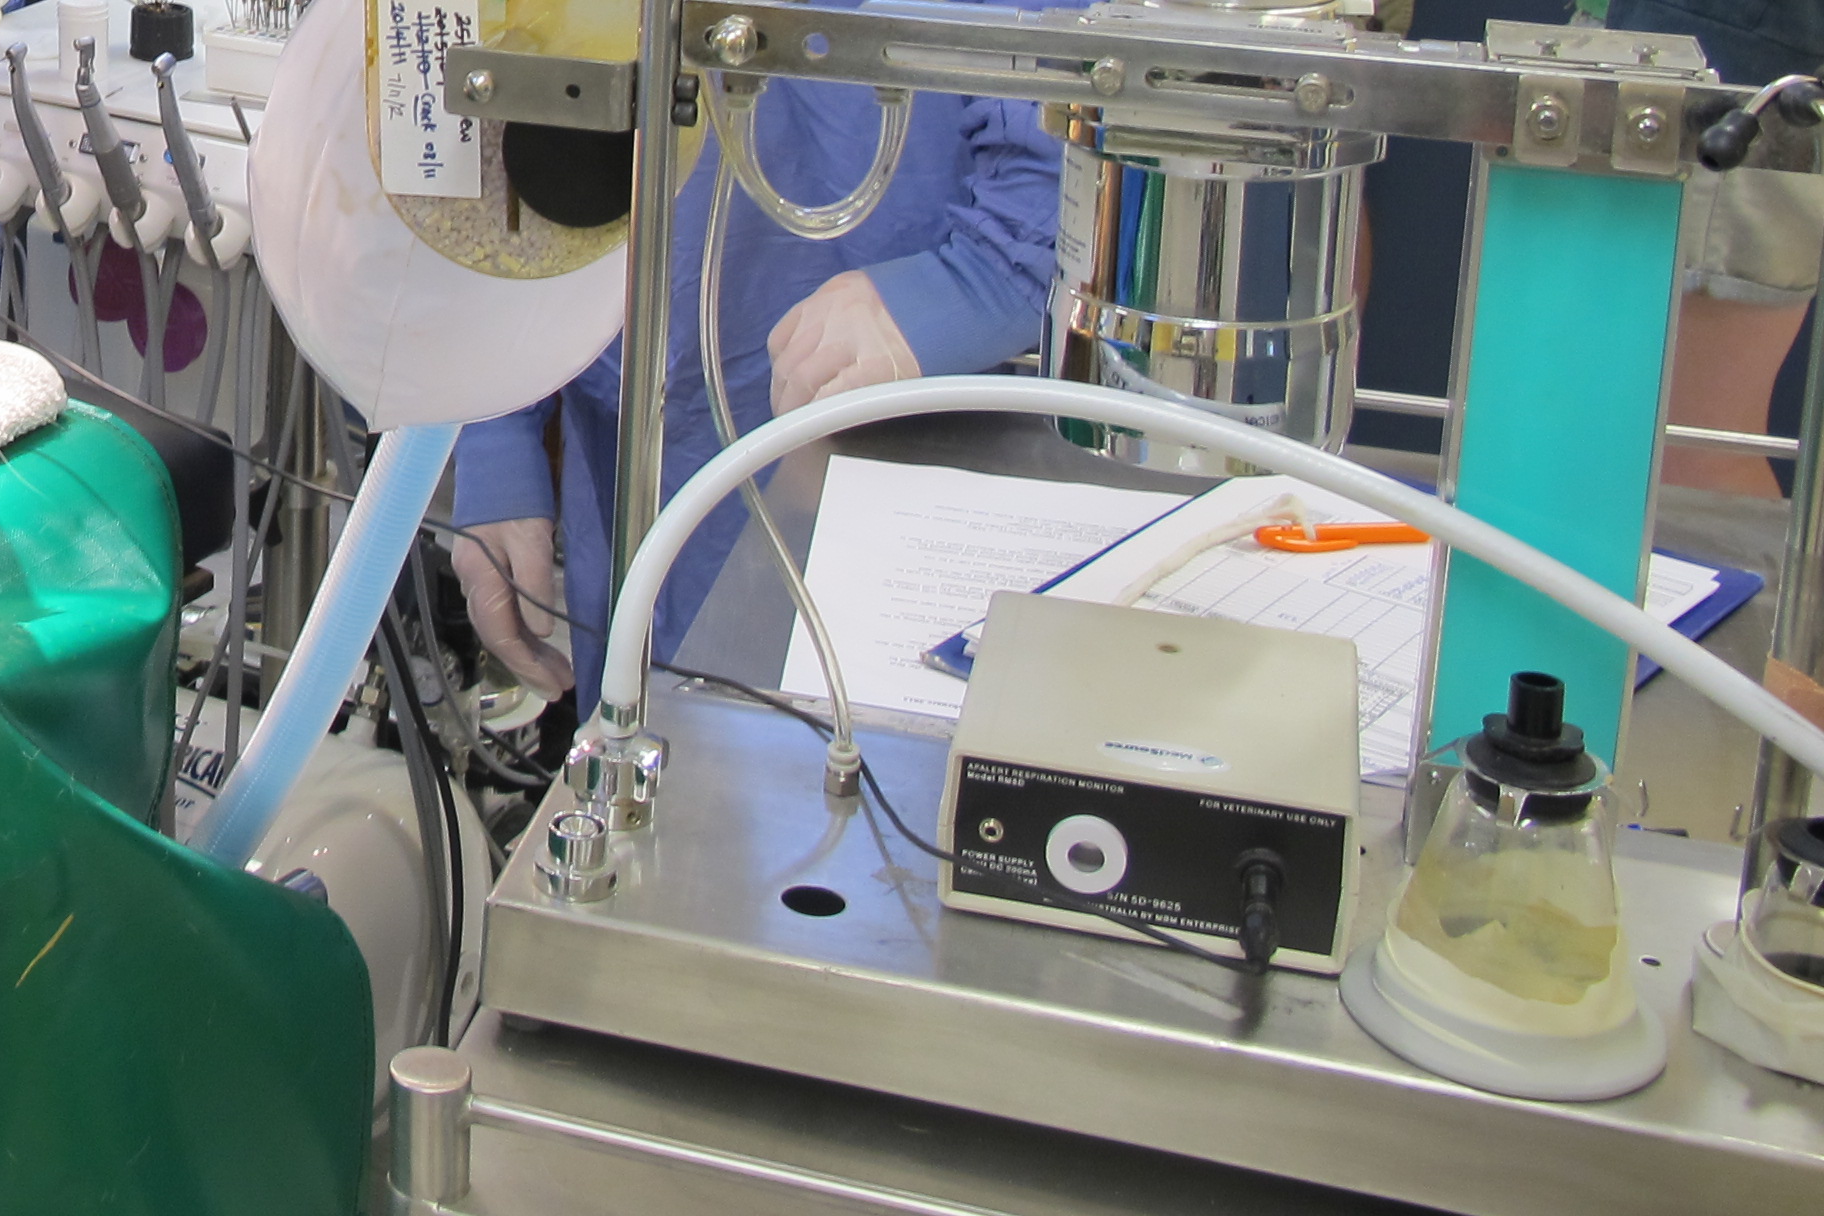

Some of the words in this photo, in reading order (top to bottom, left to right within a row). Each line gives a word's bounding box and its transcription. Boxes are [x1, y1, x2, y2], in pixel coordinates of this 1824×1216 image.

[420, 93, 437, 132] Crack
[966, 771, 995, 782] Model
[1011, 769, 1076, 787] RESPIRATION
[1077, 779, 1125, 794] MONITOR
[1199, 798, 1220, 809] FOR
[1222, 802, 1284, 819] VETERINARY
[1286, 813, 1307, 823] USE
[1308, 815, 1336, 827] ONLY
[961, 849, 996, 861] POWER
[997, 855, 1035, 867] SUPPLY
[1139, 911, 1154, 921] BY
